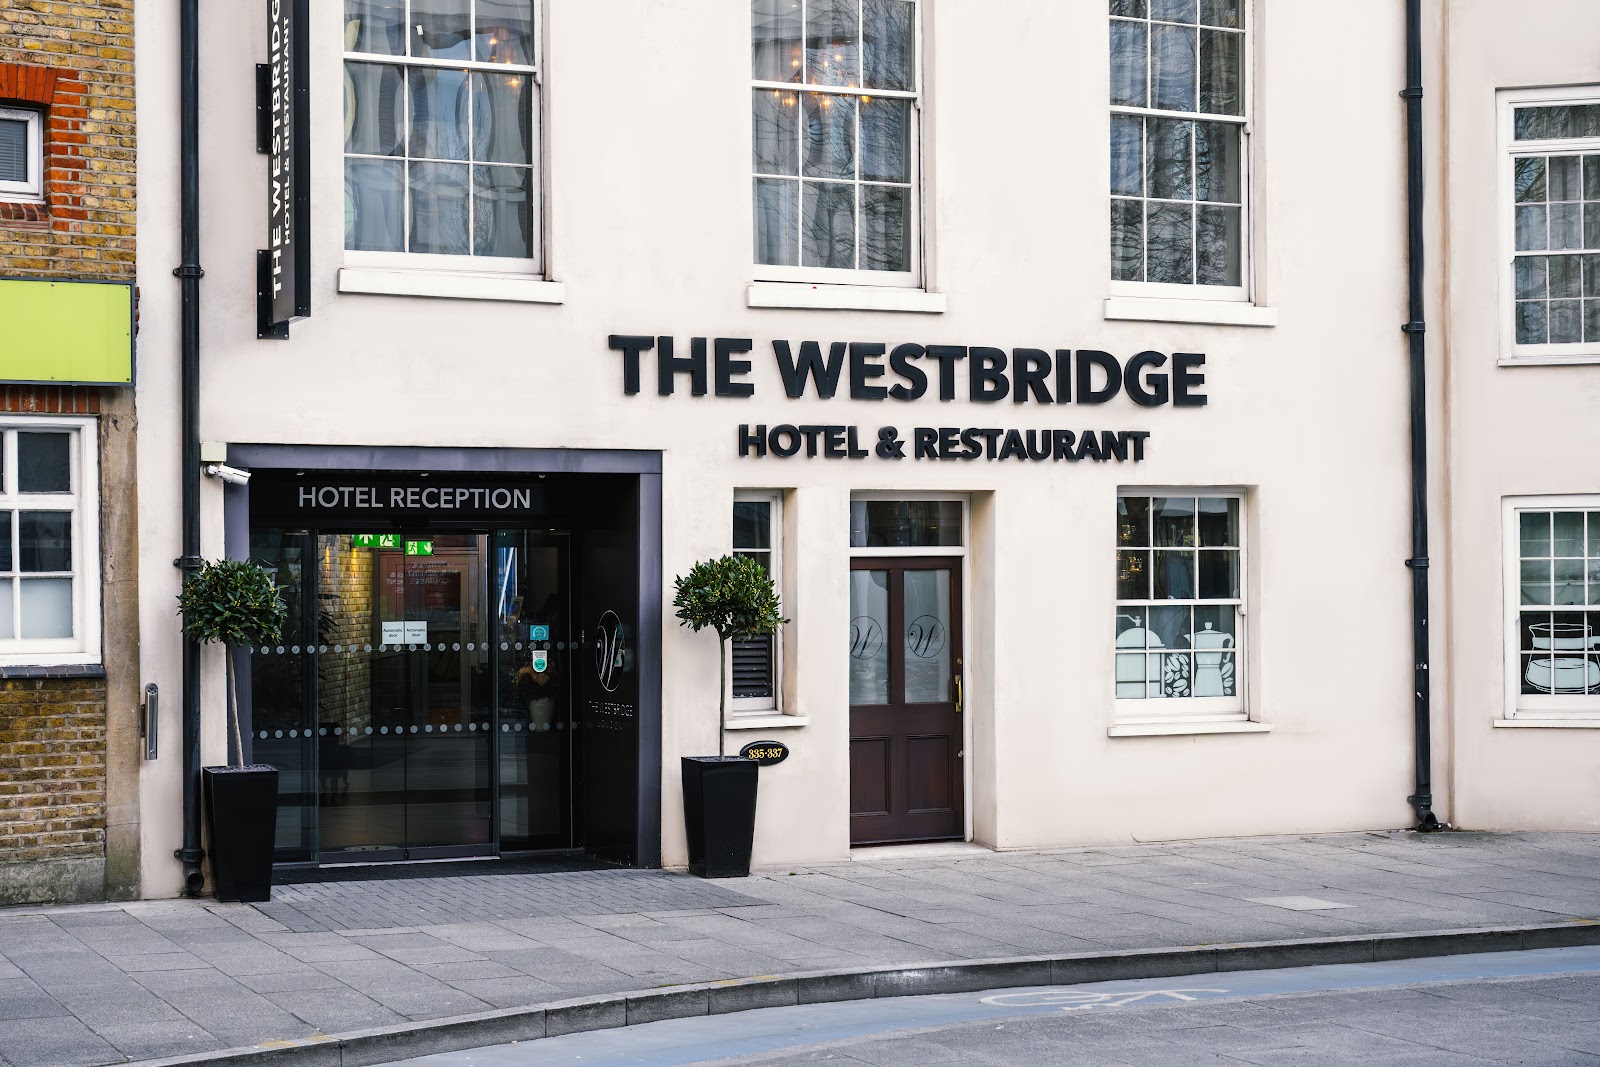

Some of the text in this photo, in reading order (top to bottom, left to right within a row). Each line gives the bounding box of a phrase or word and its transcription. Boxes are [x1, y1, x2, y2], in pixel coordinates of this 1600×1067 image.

[271, 0, 282, 300] THE WESTBRIDG
[284, 156, 290, 172] &
[608, 335, 1207, 408] THE WESTBRIDGE
[739, 424, 1150, 463] HOTEL & RESTAURANT
[299, 486, 531, 509] HOTEL RECEPTION
